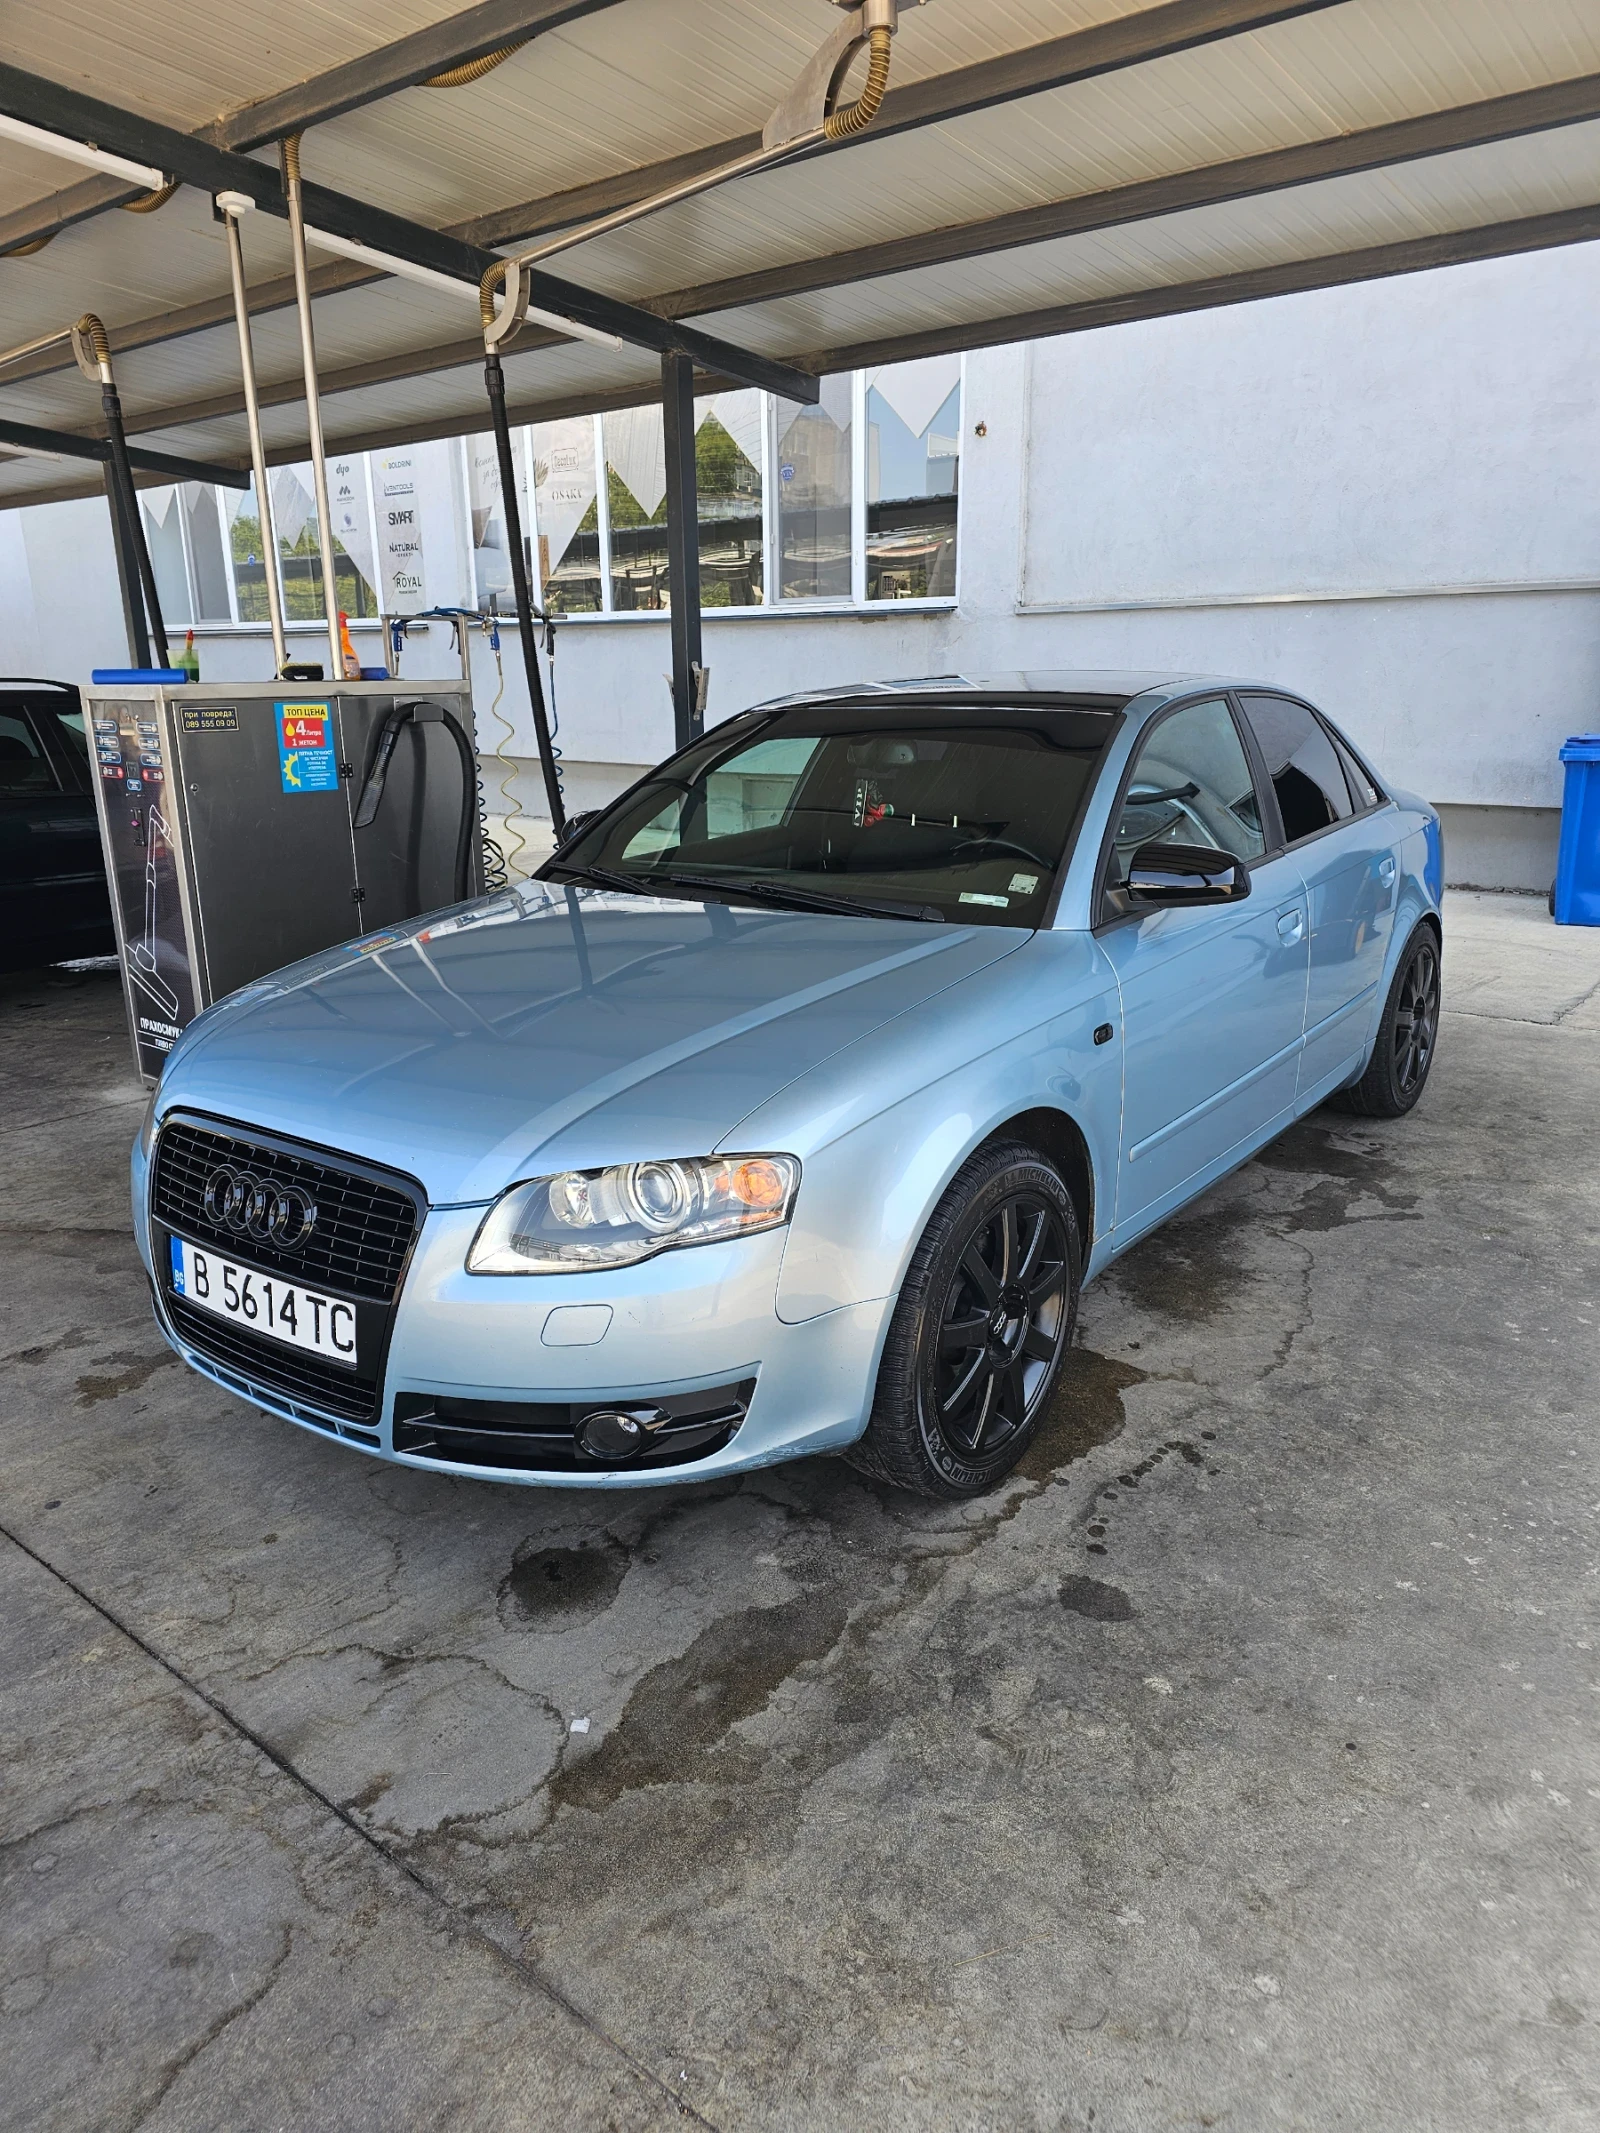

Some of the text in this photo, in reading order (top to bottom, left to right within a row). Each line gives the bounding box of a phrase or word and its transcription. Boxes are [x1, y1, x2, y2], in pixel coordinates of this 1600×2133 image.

[336, 463, 350, 476] dyo
[388, 510, 414, 526] SMART
[389, 542, 419, 553] NATURAL
[396, 576, 422, 588] ROYAL
[184, 710, 234, 719] при повреда:
[286, 708, 326, 717] ТОП ЦЕНА
[185, 719, 236, 729] 089 555 09 09
[295, 720, 307, 736] 4
[292, 738, 298, 747] 1
[1018, 1168, 1060, 1198] MICHELIN
[174, 1268, 185, 1285] BG
[194, 1251, 209, 1299] B
